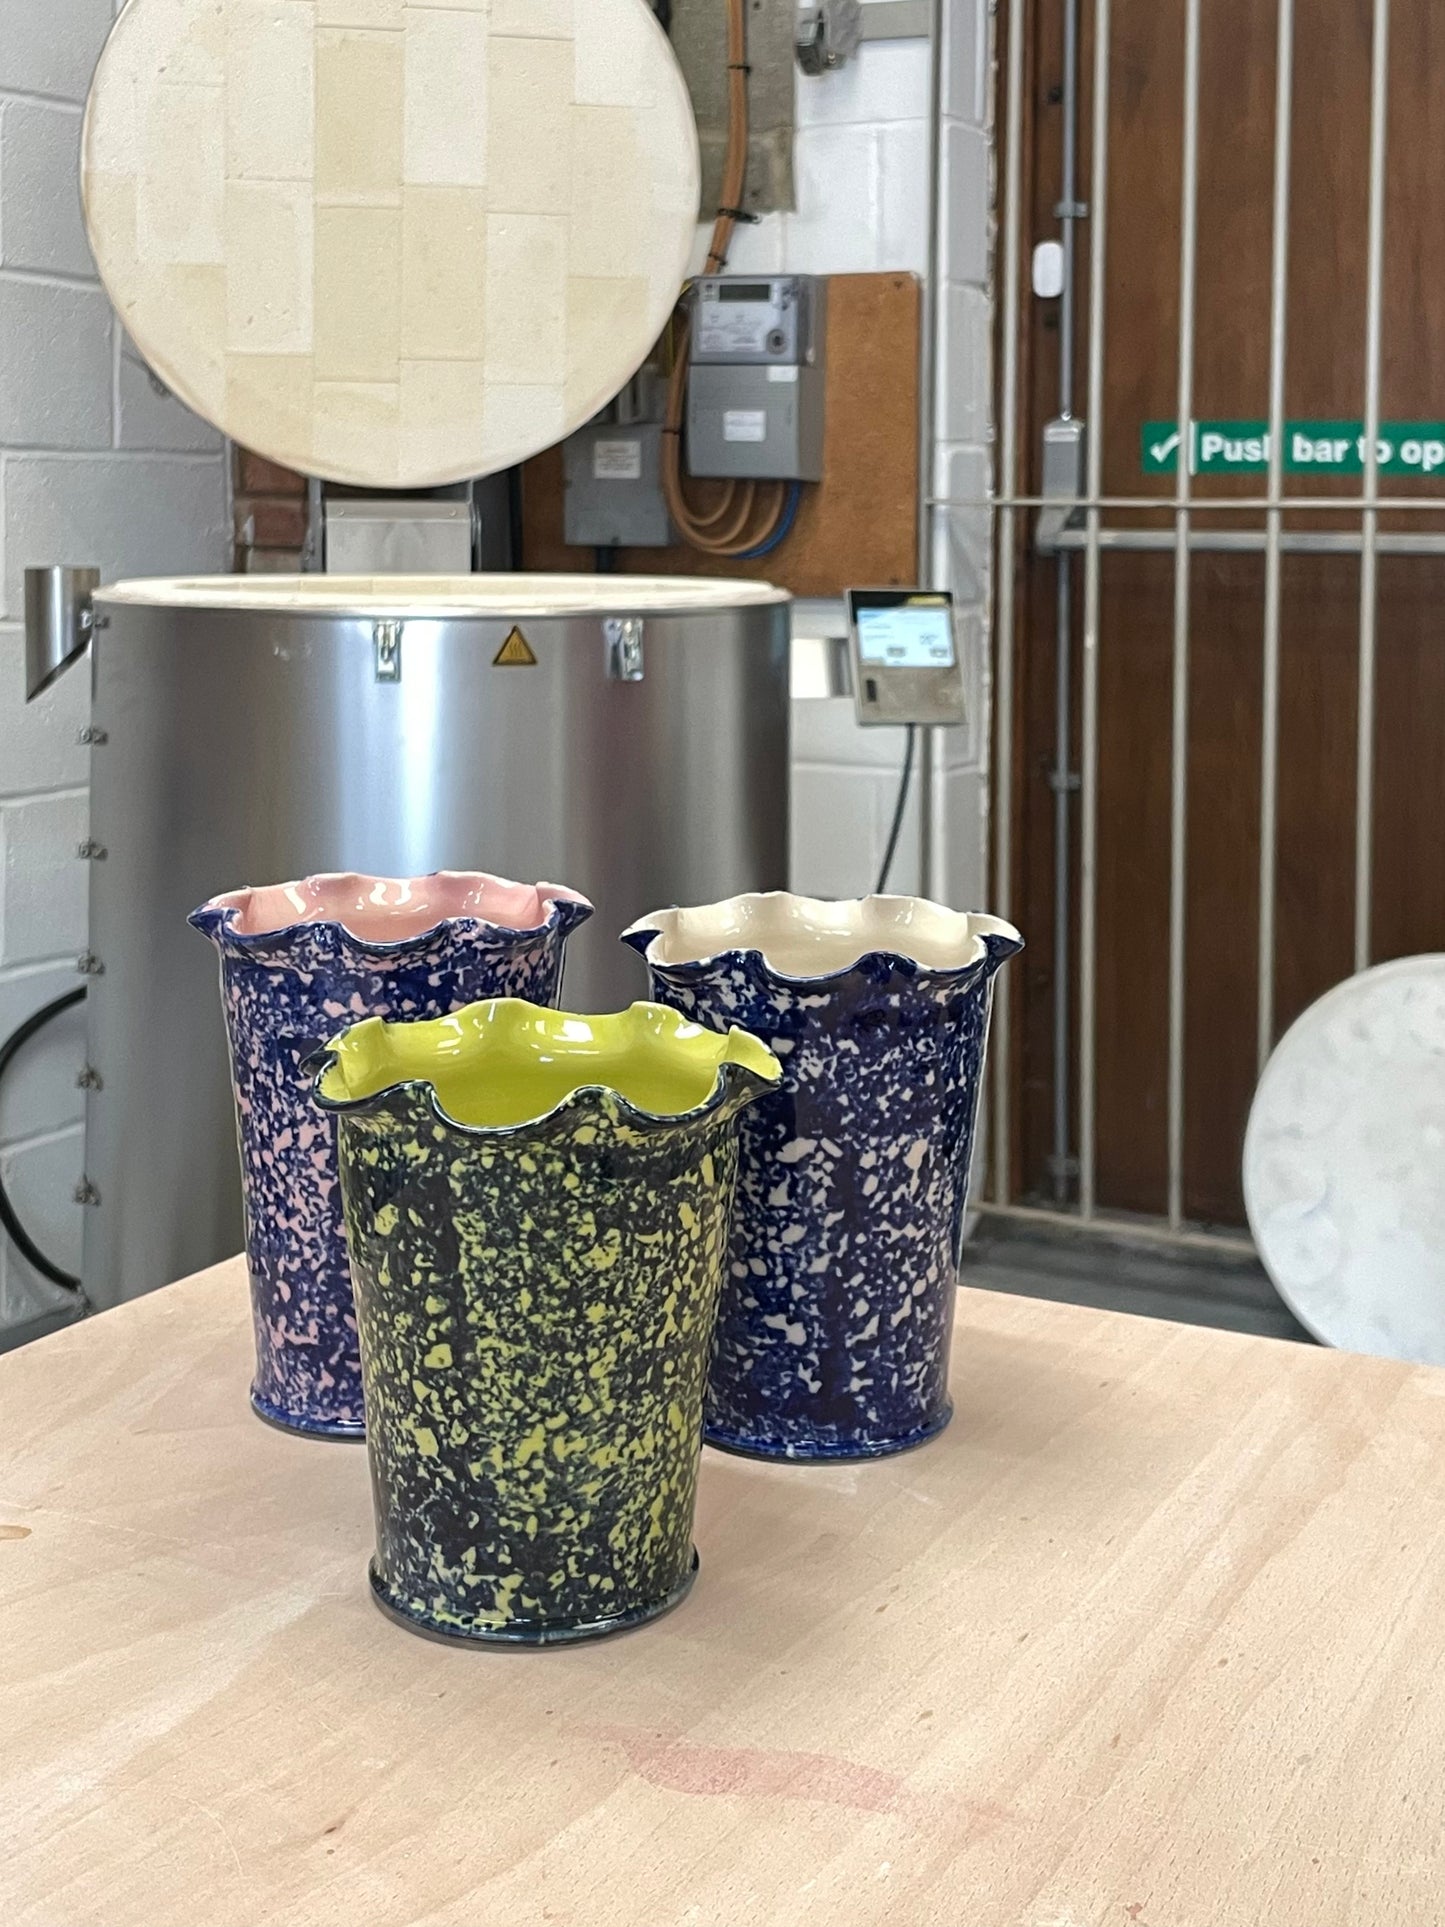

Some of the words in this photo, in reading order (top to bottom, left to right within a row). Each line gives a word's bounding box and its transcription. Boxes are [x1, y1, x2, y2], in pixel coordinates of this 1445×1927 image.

[1293, 433, 1349, 463] bar
[1356, 435, 1394, 464] to
[1401, 440, 1445, 471] op
